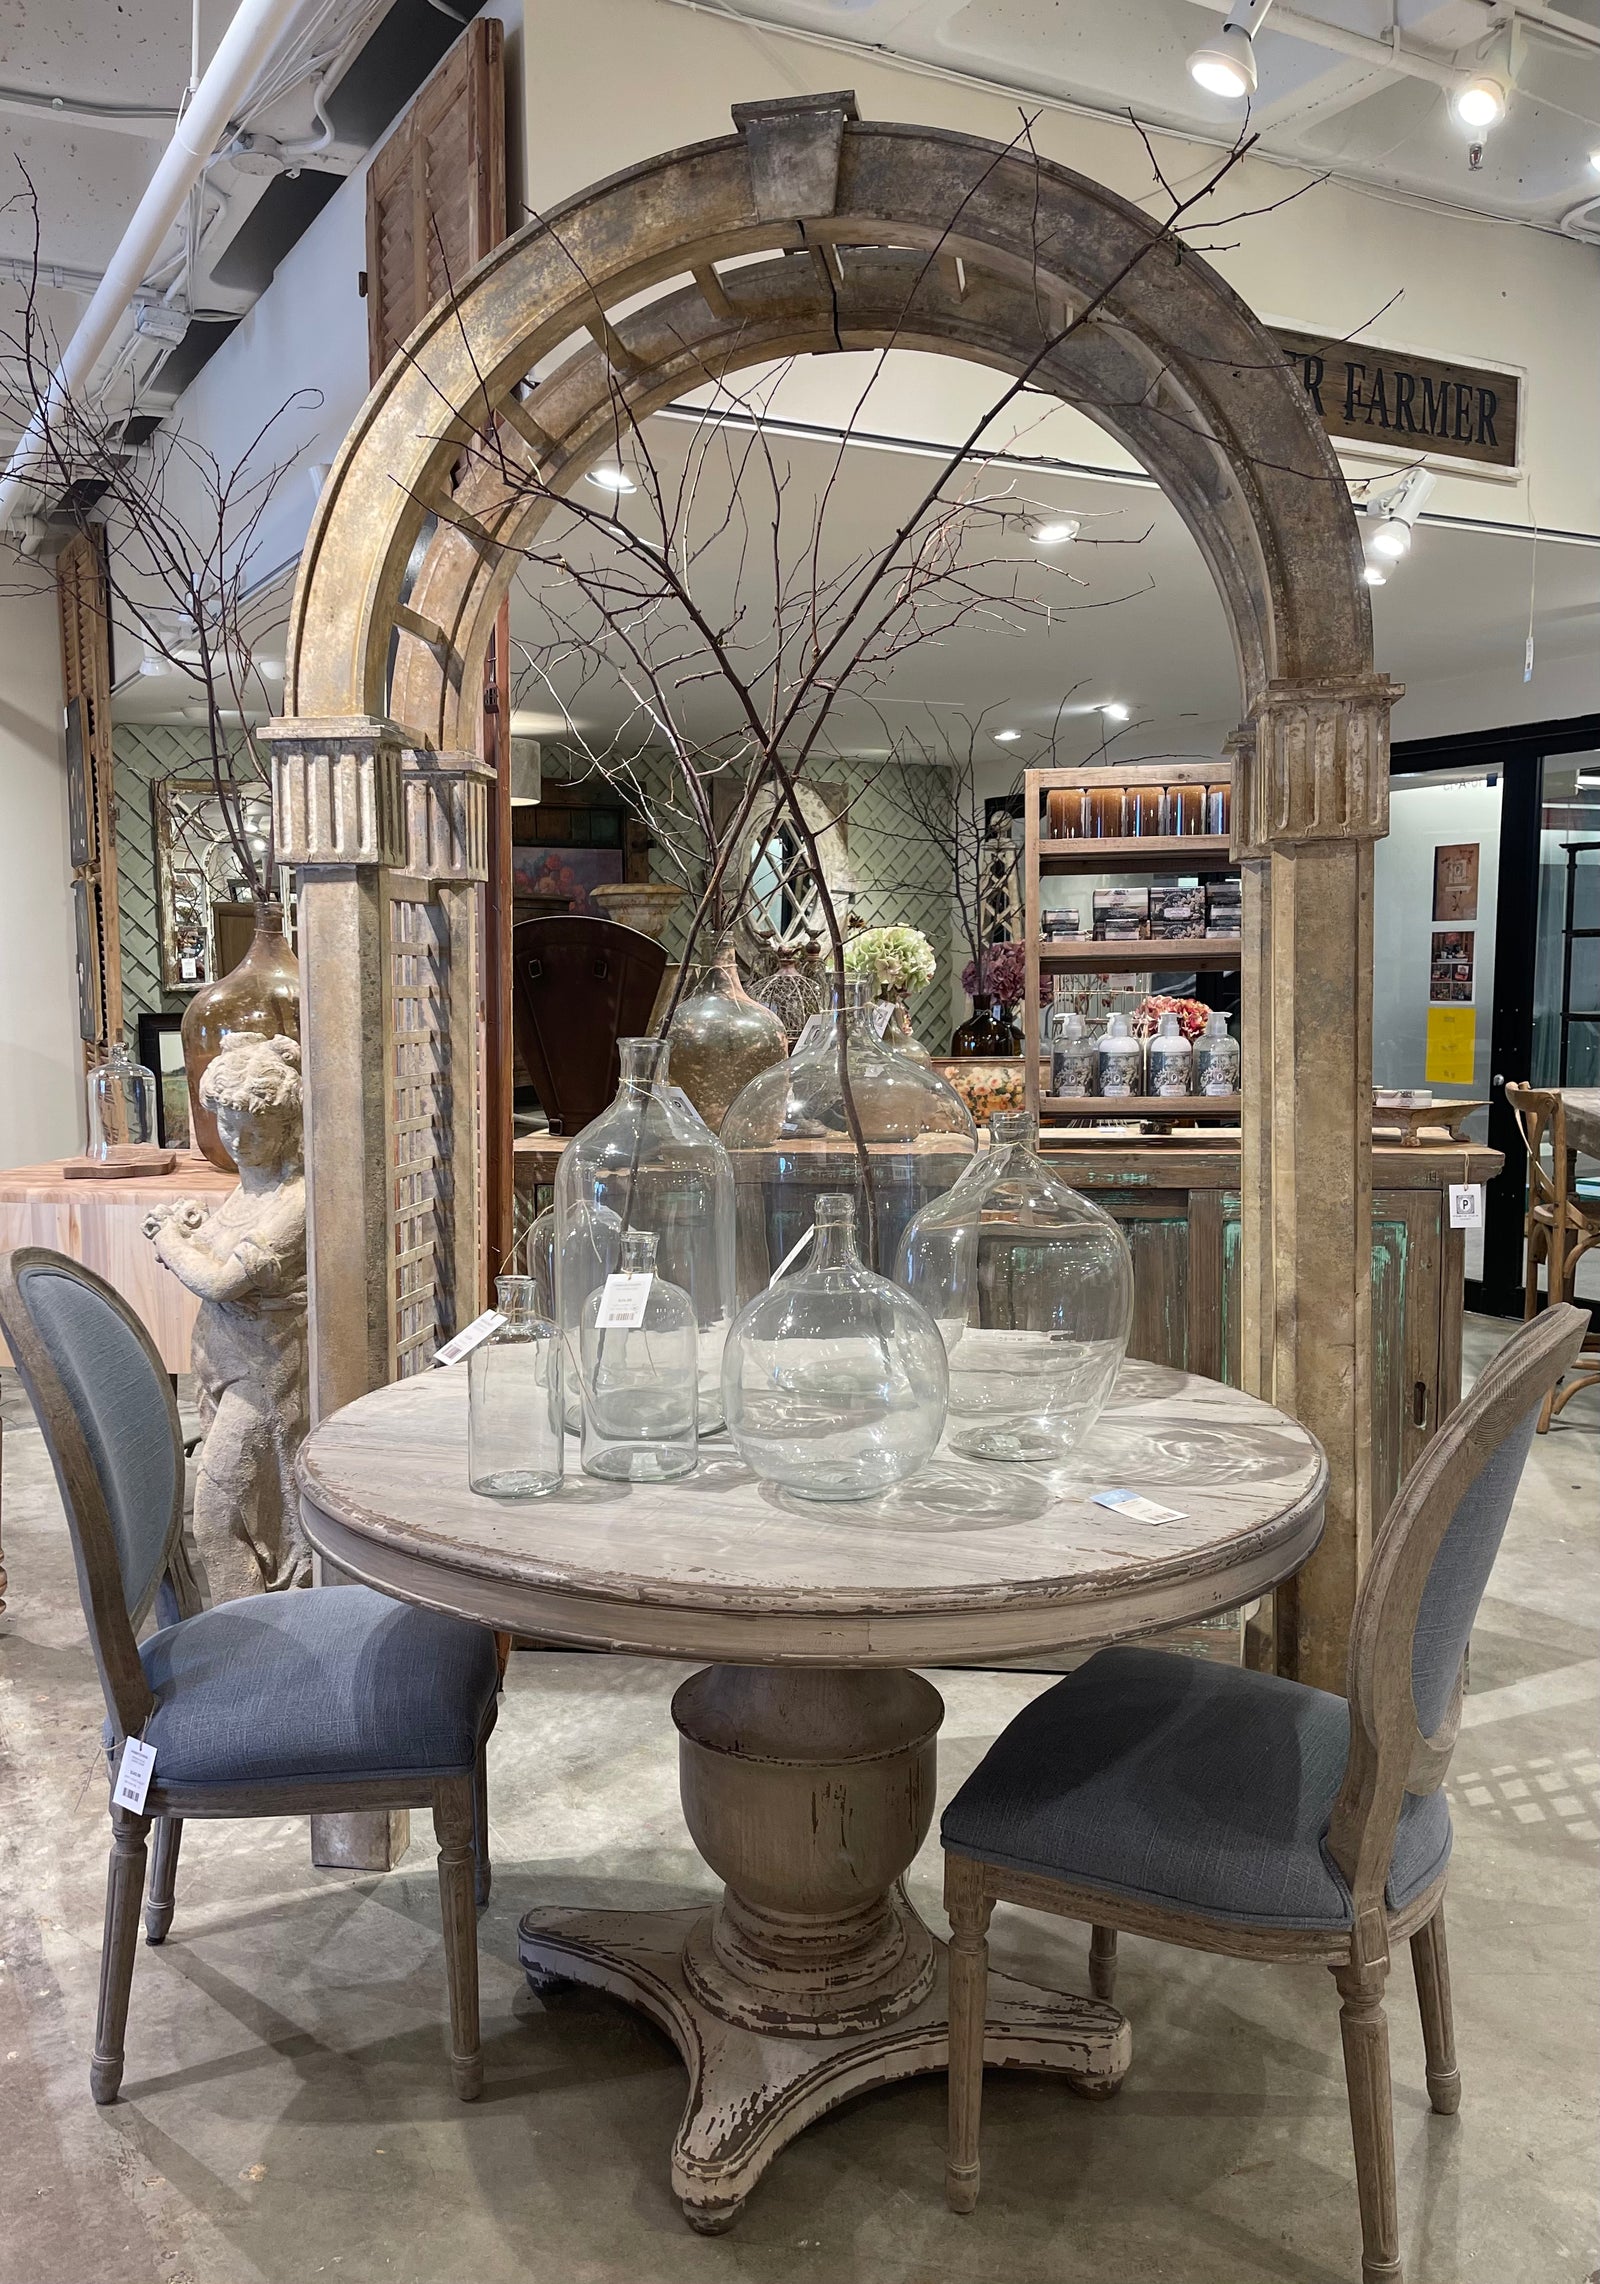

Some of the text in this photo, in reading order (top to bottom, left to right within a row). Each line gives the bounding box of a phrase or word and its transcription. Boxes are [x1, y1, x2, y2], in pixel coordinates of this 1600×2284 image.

[1281, 349, 1499, 447] R FARMER
[1463, 1199, 1469, 1210] P
